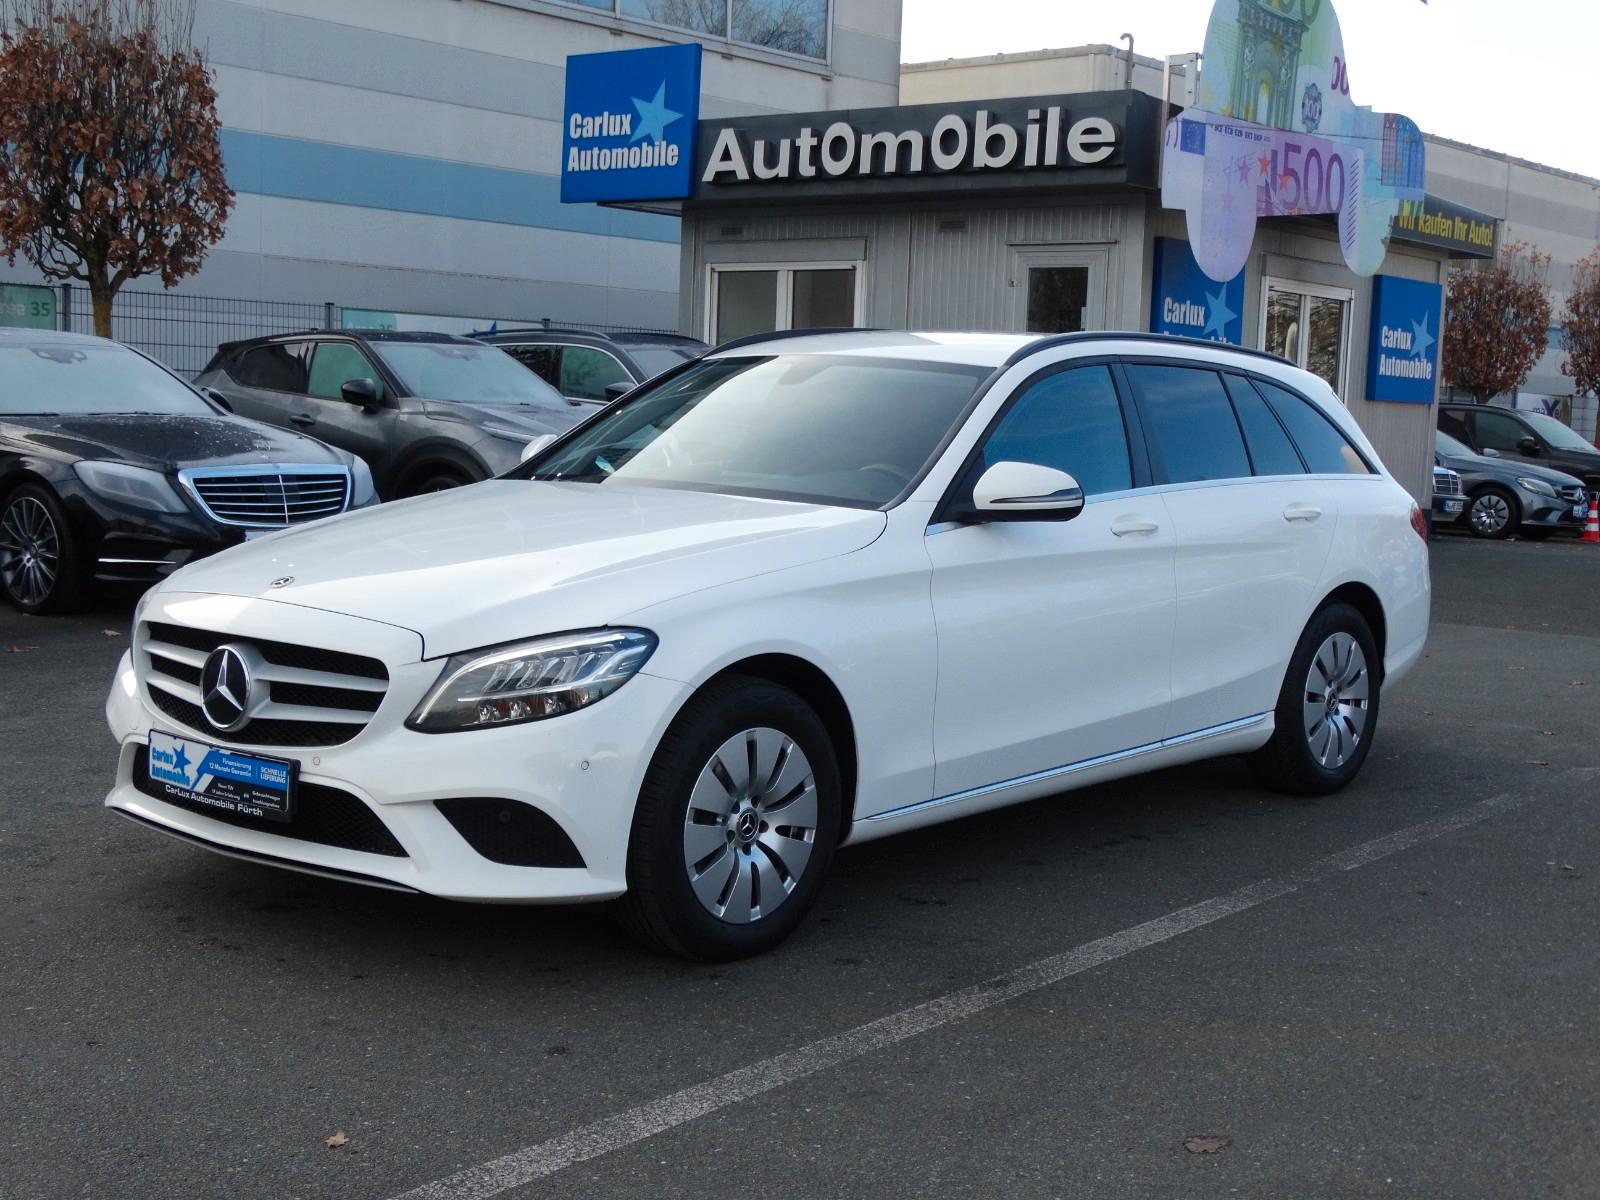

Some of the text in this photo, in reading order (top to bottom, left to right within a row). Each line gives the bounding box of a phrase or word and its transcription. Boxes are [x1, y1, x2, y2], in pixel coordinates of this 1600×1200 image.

[569, 111, 632, 139] Carlux
[567, 140, 679, 172] Automobile
[1282, 141, 1345, 213] 500
[1418, 211, 1453, 239] kaufen
[1454, 216, 1468, 241] Ihr
[1468, 220, 1494, 247] Auto!
[31, 301, 50, 317] 35
[1163, 296, 1205, 327] Carlux
[1381, 325, 1412, 350] Carlux
[1379, 353, 1432, 380] Automobile
[260, 766, 287, 778] SCHNELLE
[165, 784, 190, 798] CarLux
[190, 793, 235, 810] Automobile
[237, 803, 263, 817] Fürth
